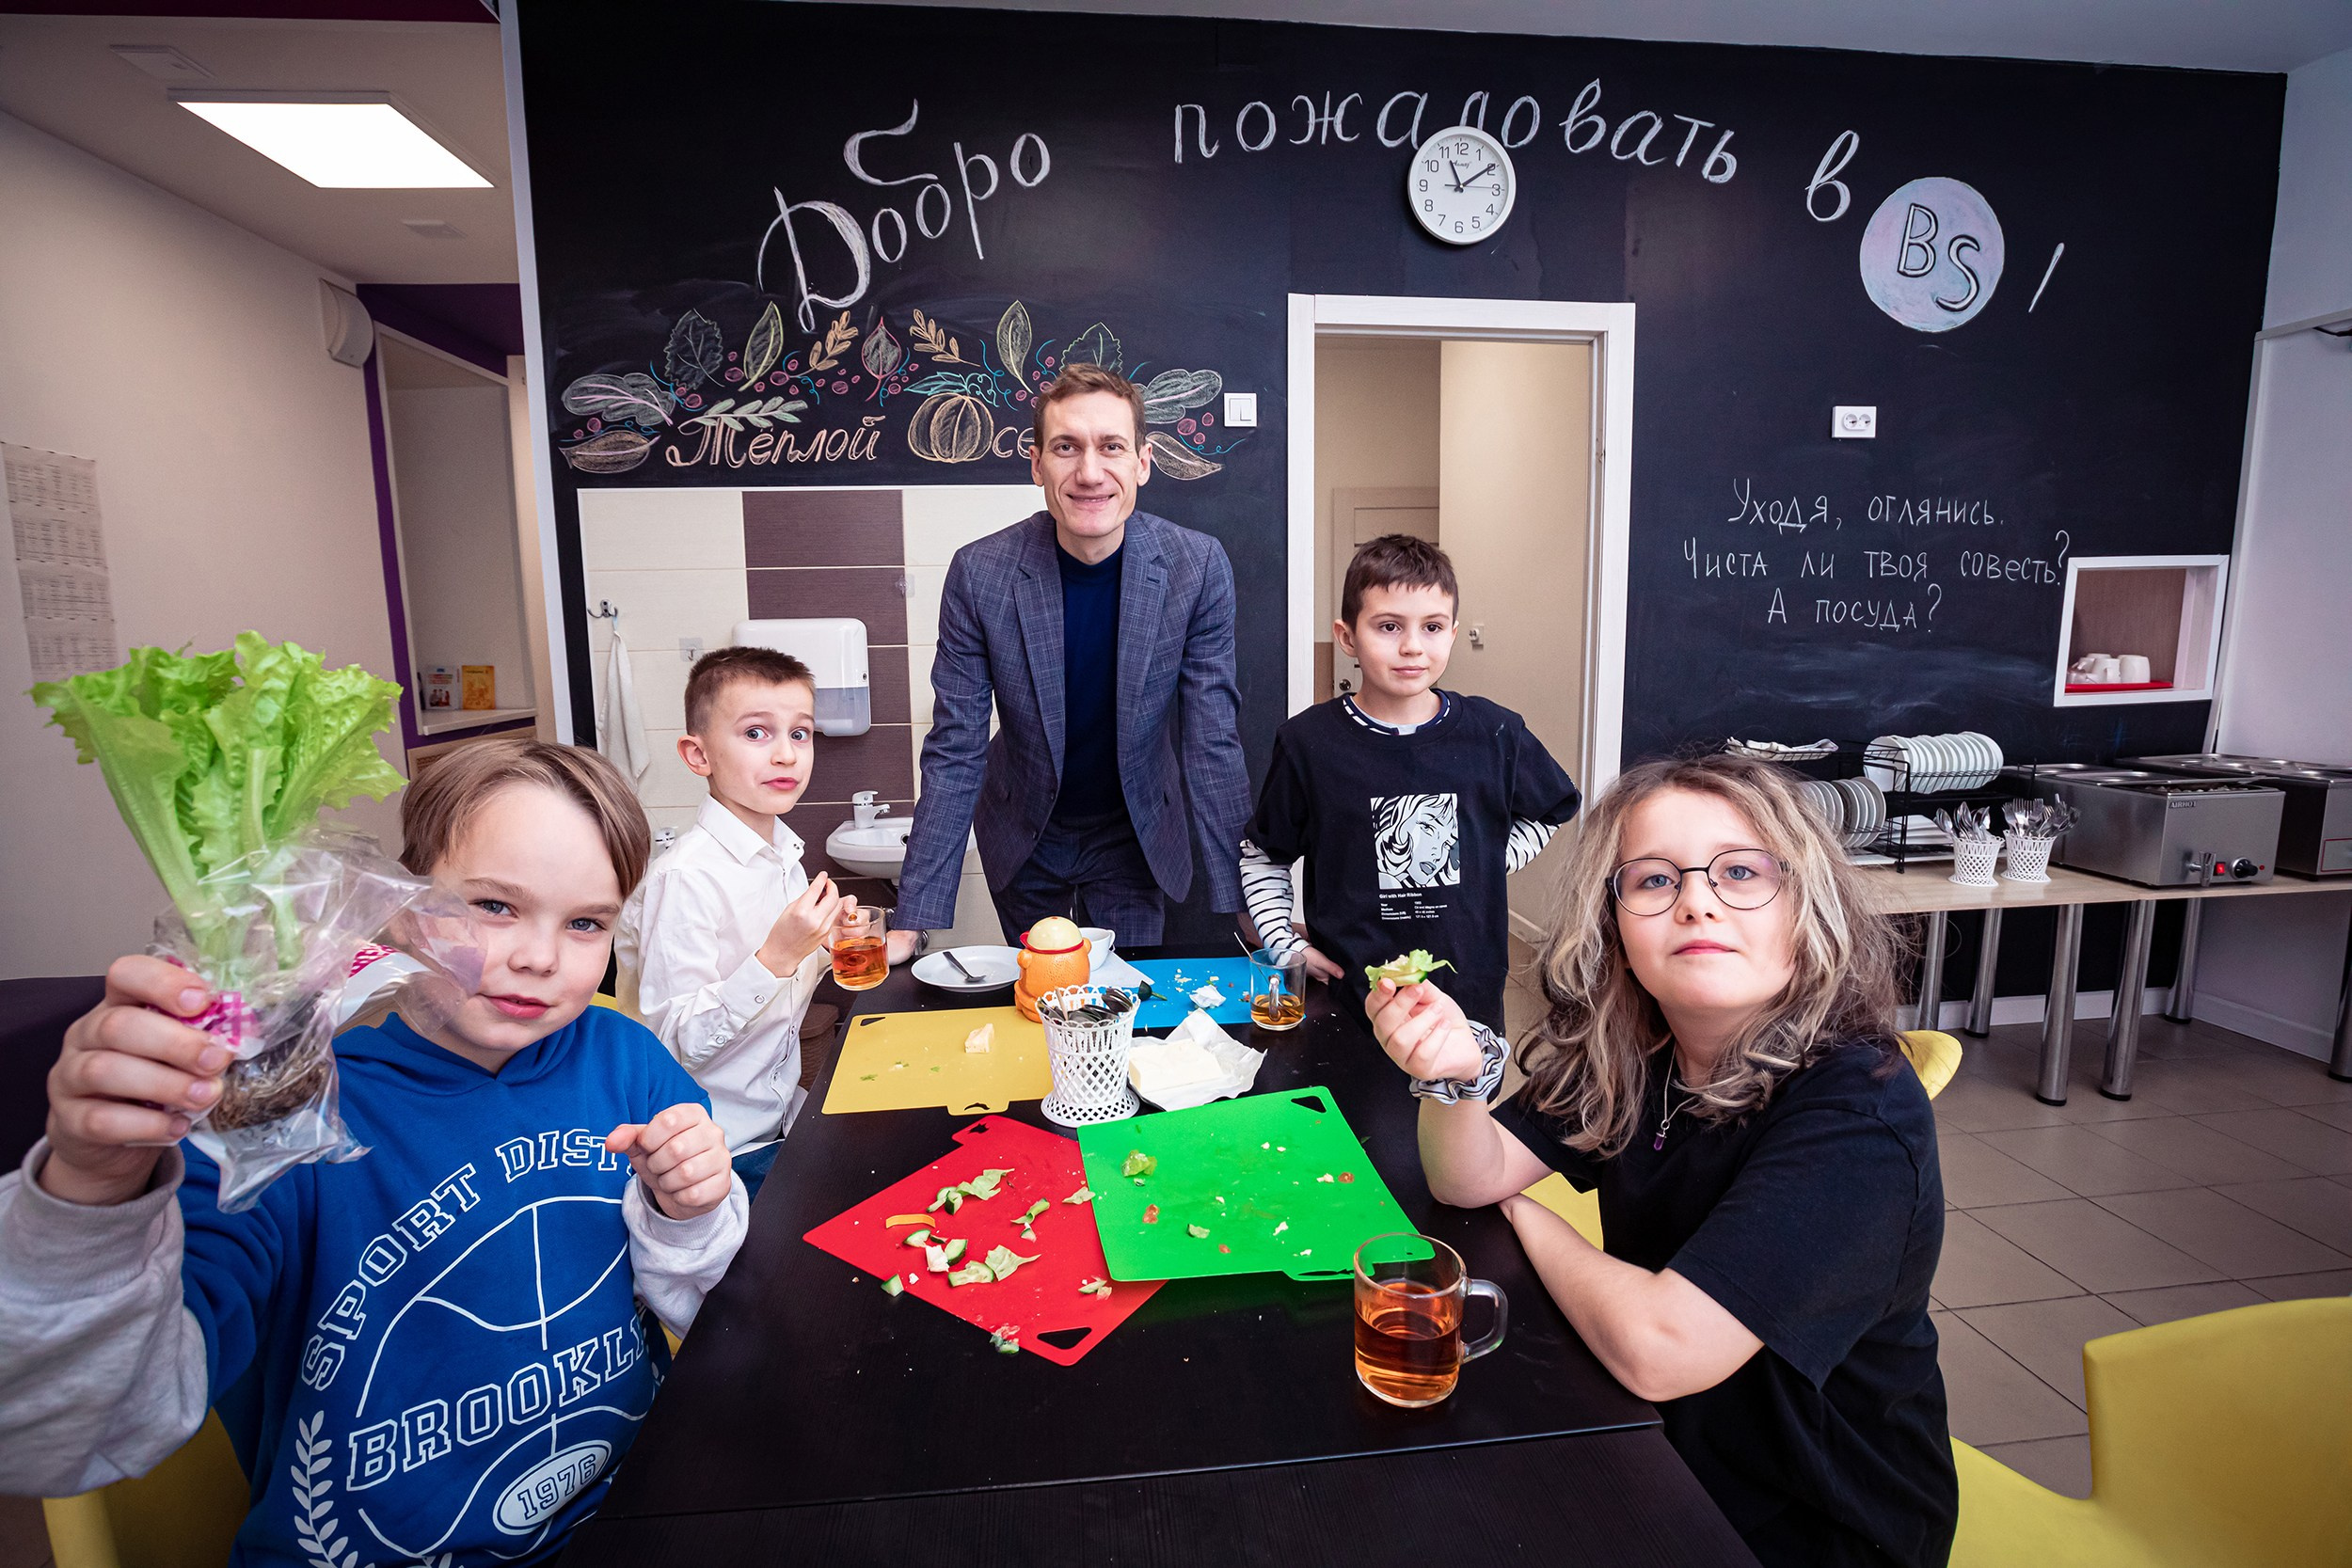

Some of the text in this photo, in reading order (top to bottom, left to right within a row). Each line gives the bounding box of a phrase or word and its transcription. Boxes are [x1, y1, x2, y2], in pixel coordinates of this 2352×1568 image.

[1438, 146, 1450, 159] 11
[1454, 142, 1469, 155] 12
[1475, 149, 1481, 161] 1
[1424, 160, 1439, 172] 10
[1419, 179, 1428, 192] 9
[1491, 184, 1501, 197] 3
[757, 78, 1860, 333] Добро пожаловать в
[1424, 199, 1434, 212] 8
[1486, 203, 1494, 215] 4
[1438, 214, 1446, 227] 7
[1454, 221, 1464, 233] 6
[1471, 216, 1481, 229] 5
[1897, 202, 1980, 312] BS
[665, 415, 886, 468] Тёплой
[1727, 478, 2004, 534] Уходя, оглянись.
[1801, 551, 1835, 578] ли
[1864, 550, 1929, 583] твоя
[1961, 530, 2070, 585] совесть?
[1768, 583, 1942, 632] А посуда?
[301, 1129, 631, 1391] SPORT DIST
[517, 1453, 596, 1521] 1976
